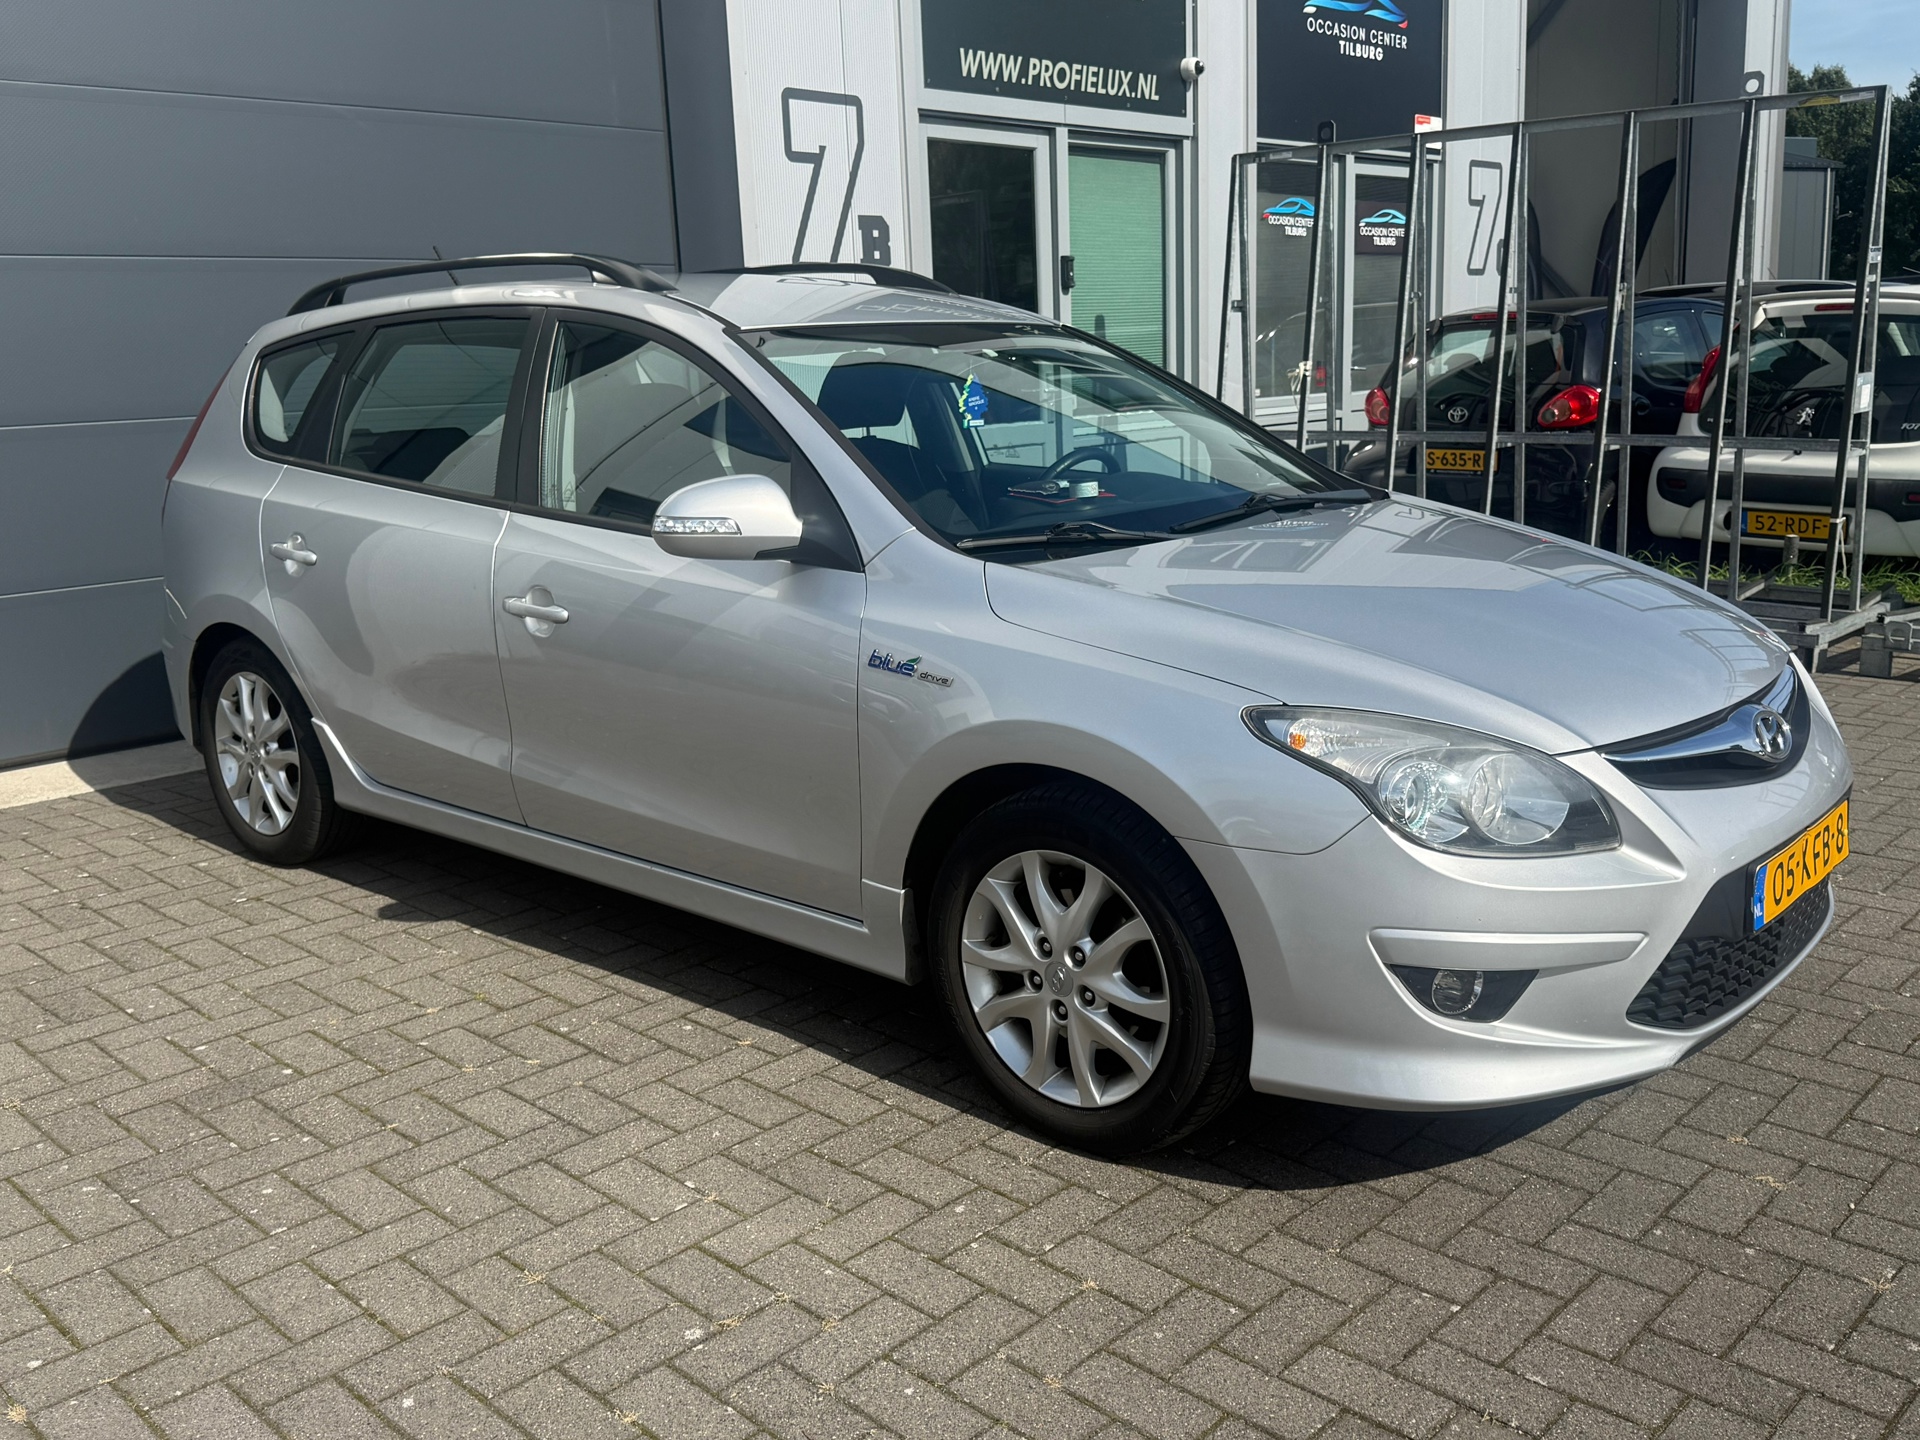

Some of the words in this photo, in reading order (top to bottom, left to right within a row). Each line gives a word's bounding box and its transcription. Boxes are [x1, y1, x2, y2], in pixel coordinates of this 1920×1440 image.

[1306, 16, 1366, 42] OCCASION
[1369, 29, 1408, 50] CENTER
[1338, 40, 1384, 61] TILBURG
[959, 47, 1160, 101] WWW.PROFIELUX.NL
[1268, 215, 1294, 226] OCCASION
[1284, 226, 1307, 237] TILBURG
[1360, 226, 1387, 237] OCCASION
[1388, 228, 1405, 238] CENTE
[1373, 236, 1396, 246] TILBURG
[1900, 422, 1920, 430] 107
[1427, 451, 1485, 468] S-635-R
[1755, 515, 1829, 535] 52-RDF-
[867, 649, 919, 677] blue
[919, 671, 949, 685] drive
[1772, 812, 1845, 906] 05-KFB-8
[1753, 902, 1763, 919] NL
